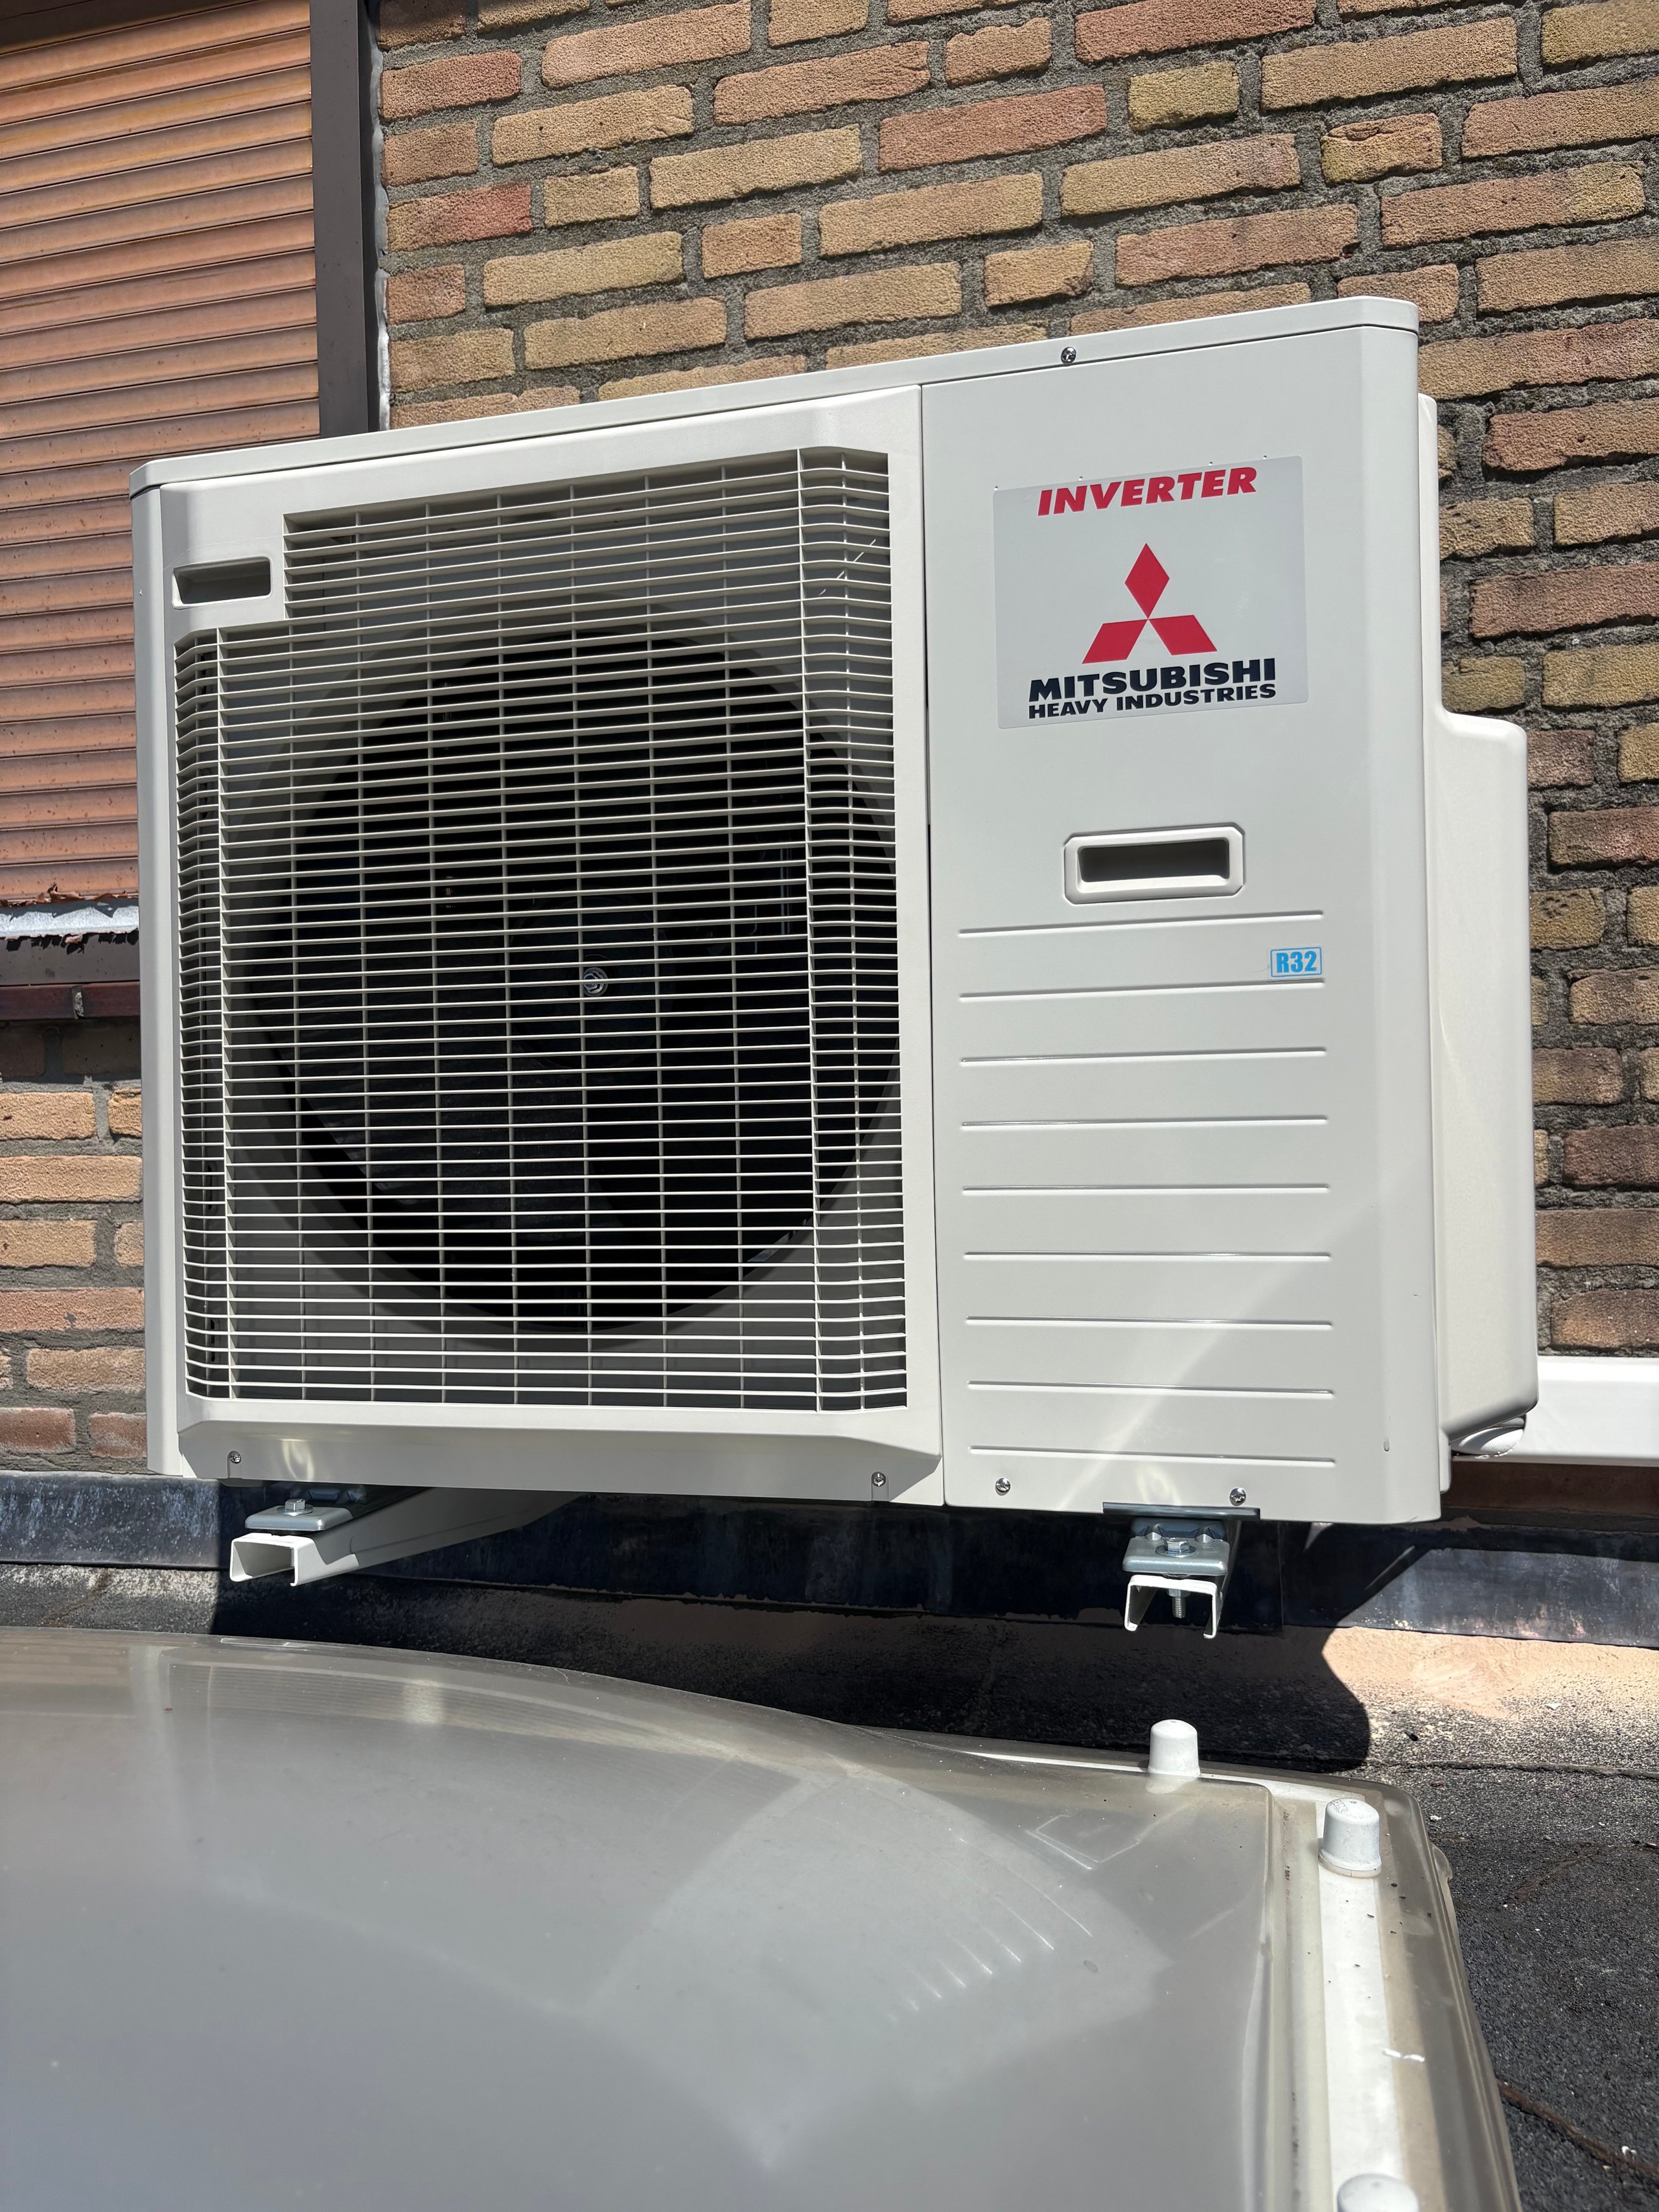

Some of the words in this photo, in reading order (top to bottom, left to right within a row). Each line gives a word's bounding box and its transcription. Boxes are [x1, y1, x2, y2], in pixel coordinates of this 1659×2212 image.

[1037, 466, 1258, 517] INVERTER
[1028, 658, 1276, 702] MITSUBISHI
[1028, 697, 1108, 719] HEAVY
[1116, 683, 1277, 712] INDUSTRIES
[1276, 950, 1317, 973] R32
